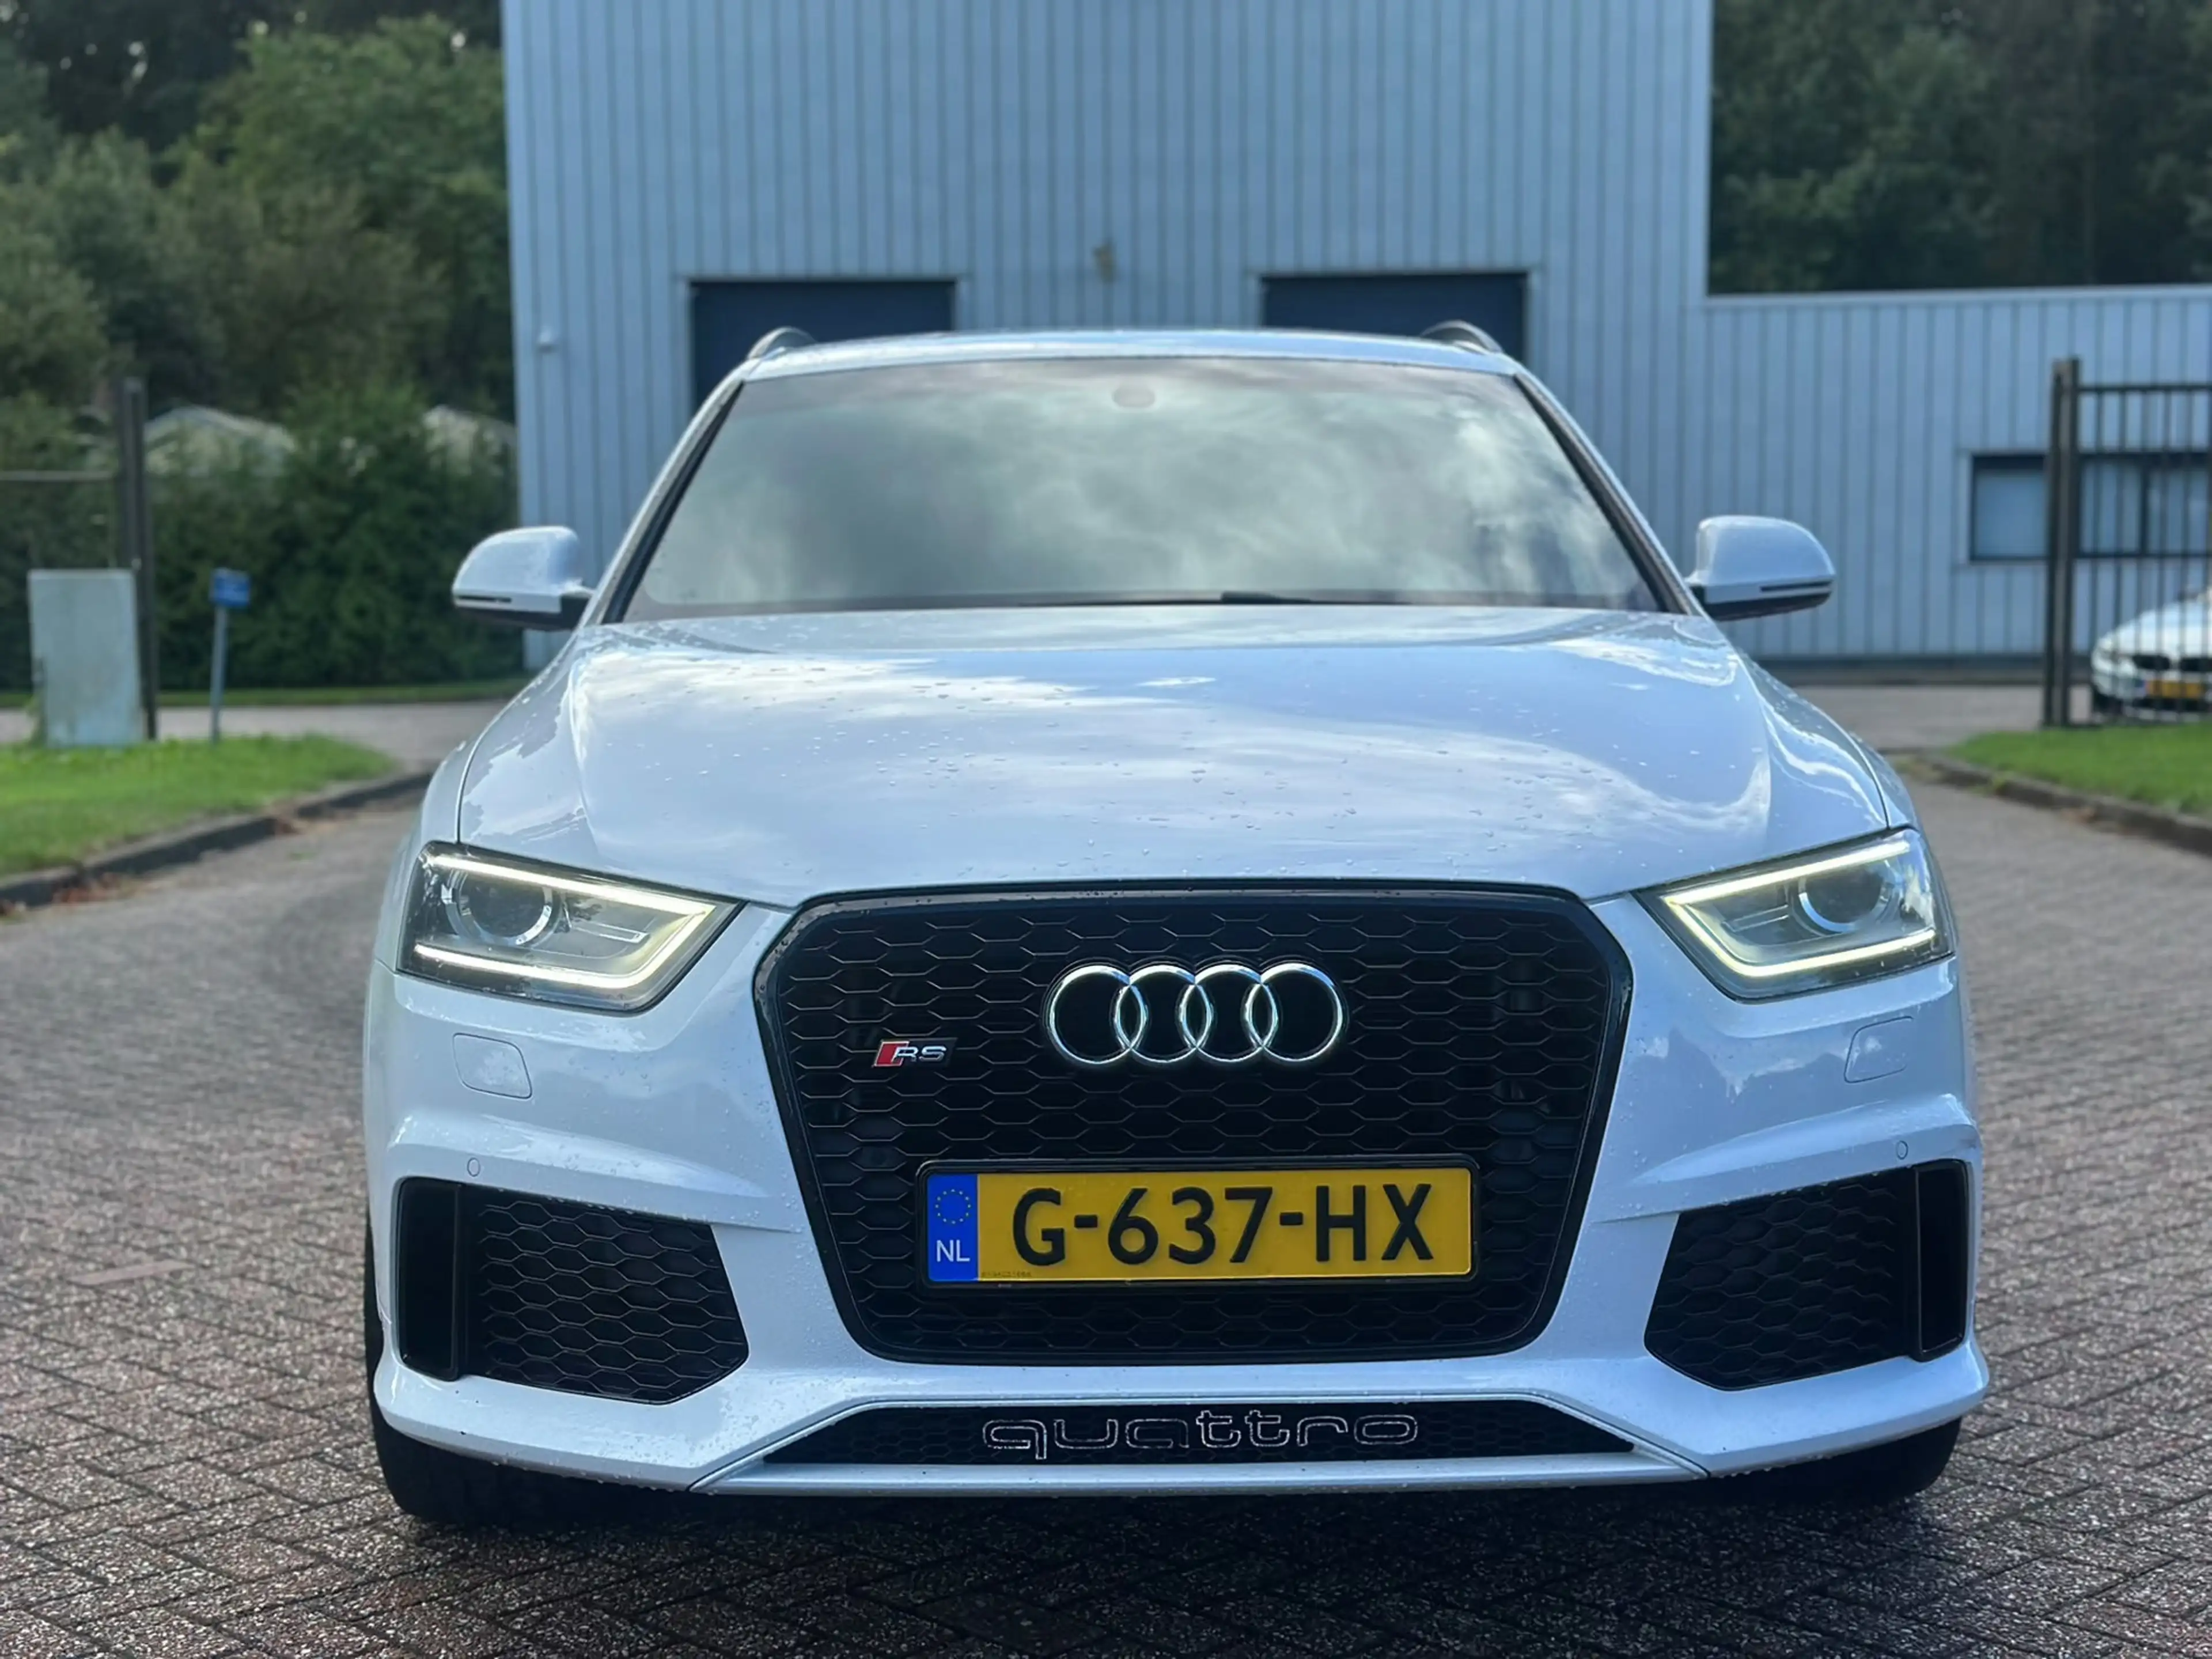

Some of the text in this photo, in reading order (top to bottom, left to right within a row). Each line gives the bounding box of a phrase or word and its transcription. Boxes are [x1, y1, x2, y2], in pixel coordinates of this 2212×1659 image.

[891, 1046, 946, 1062] RS
[1013, 1184, 1434, 1266] G-637-HX
[935, 1240, 970, 1262] NL
[982, 1410, 1418, 1460] quattro
